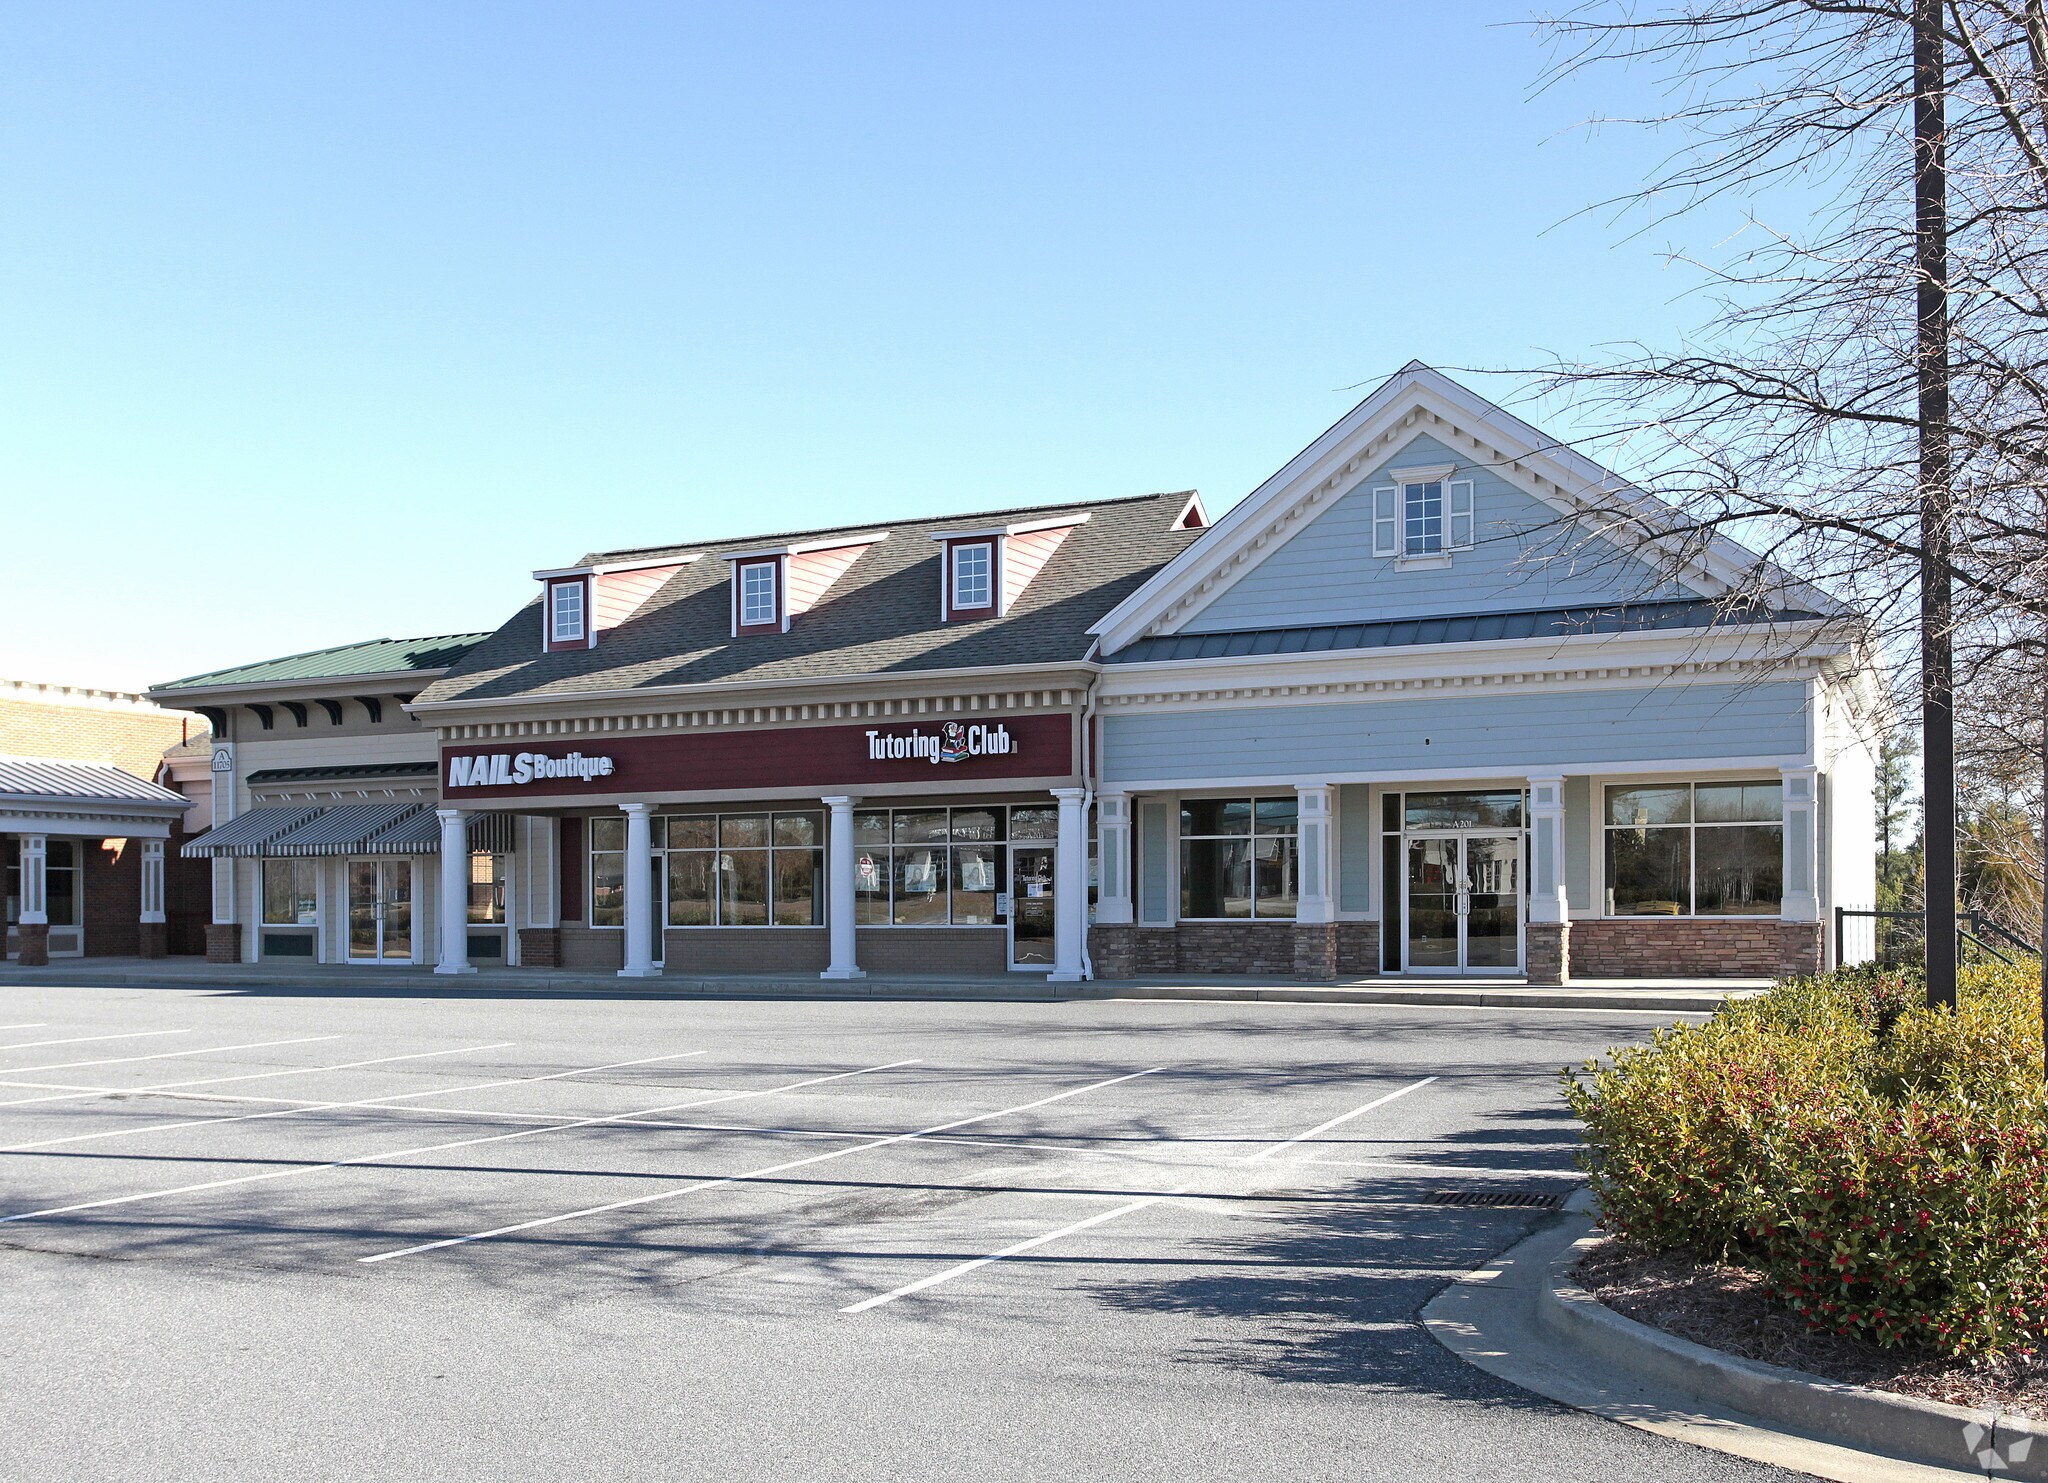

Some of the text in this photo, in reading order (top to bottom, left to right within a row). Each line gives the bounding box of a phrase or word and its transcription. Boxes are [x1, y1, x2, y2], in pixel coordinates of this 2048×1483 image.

[865, 724, 1010, 764] Tutoring Club
[213, 761, 230, 770] 11705
[219, 752, 225, 760] A
[449, 752, 614, 787] NAILS Boutique
